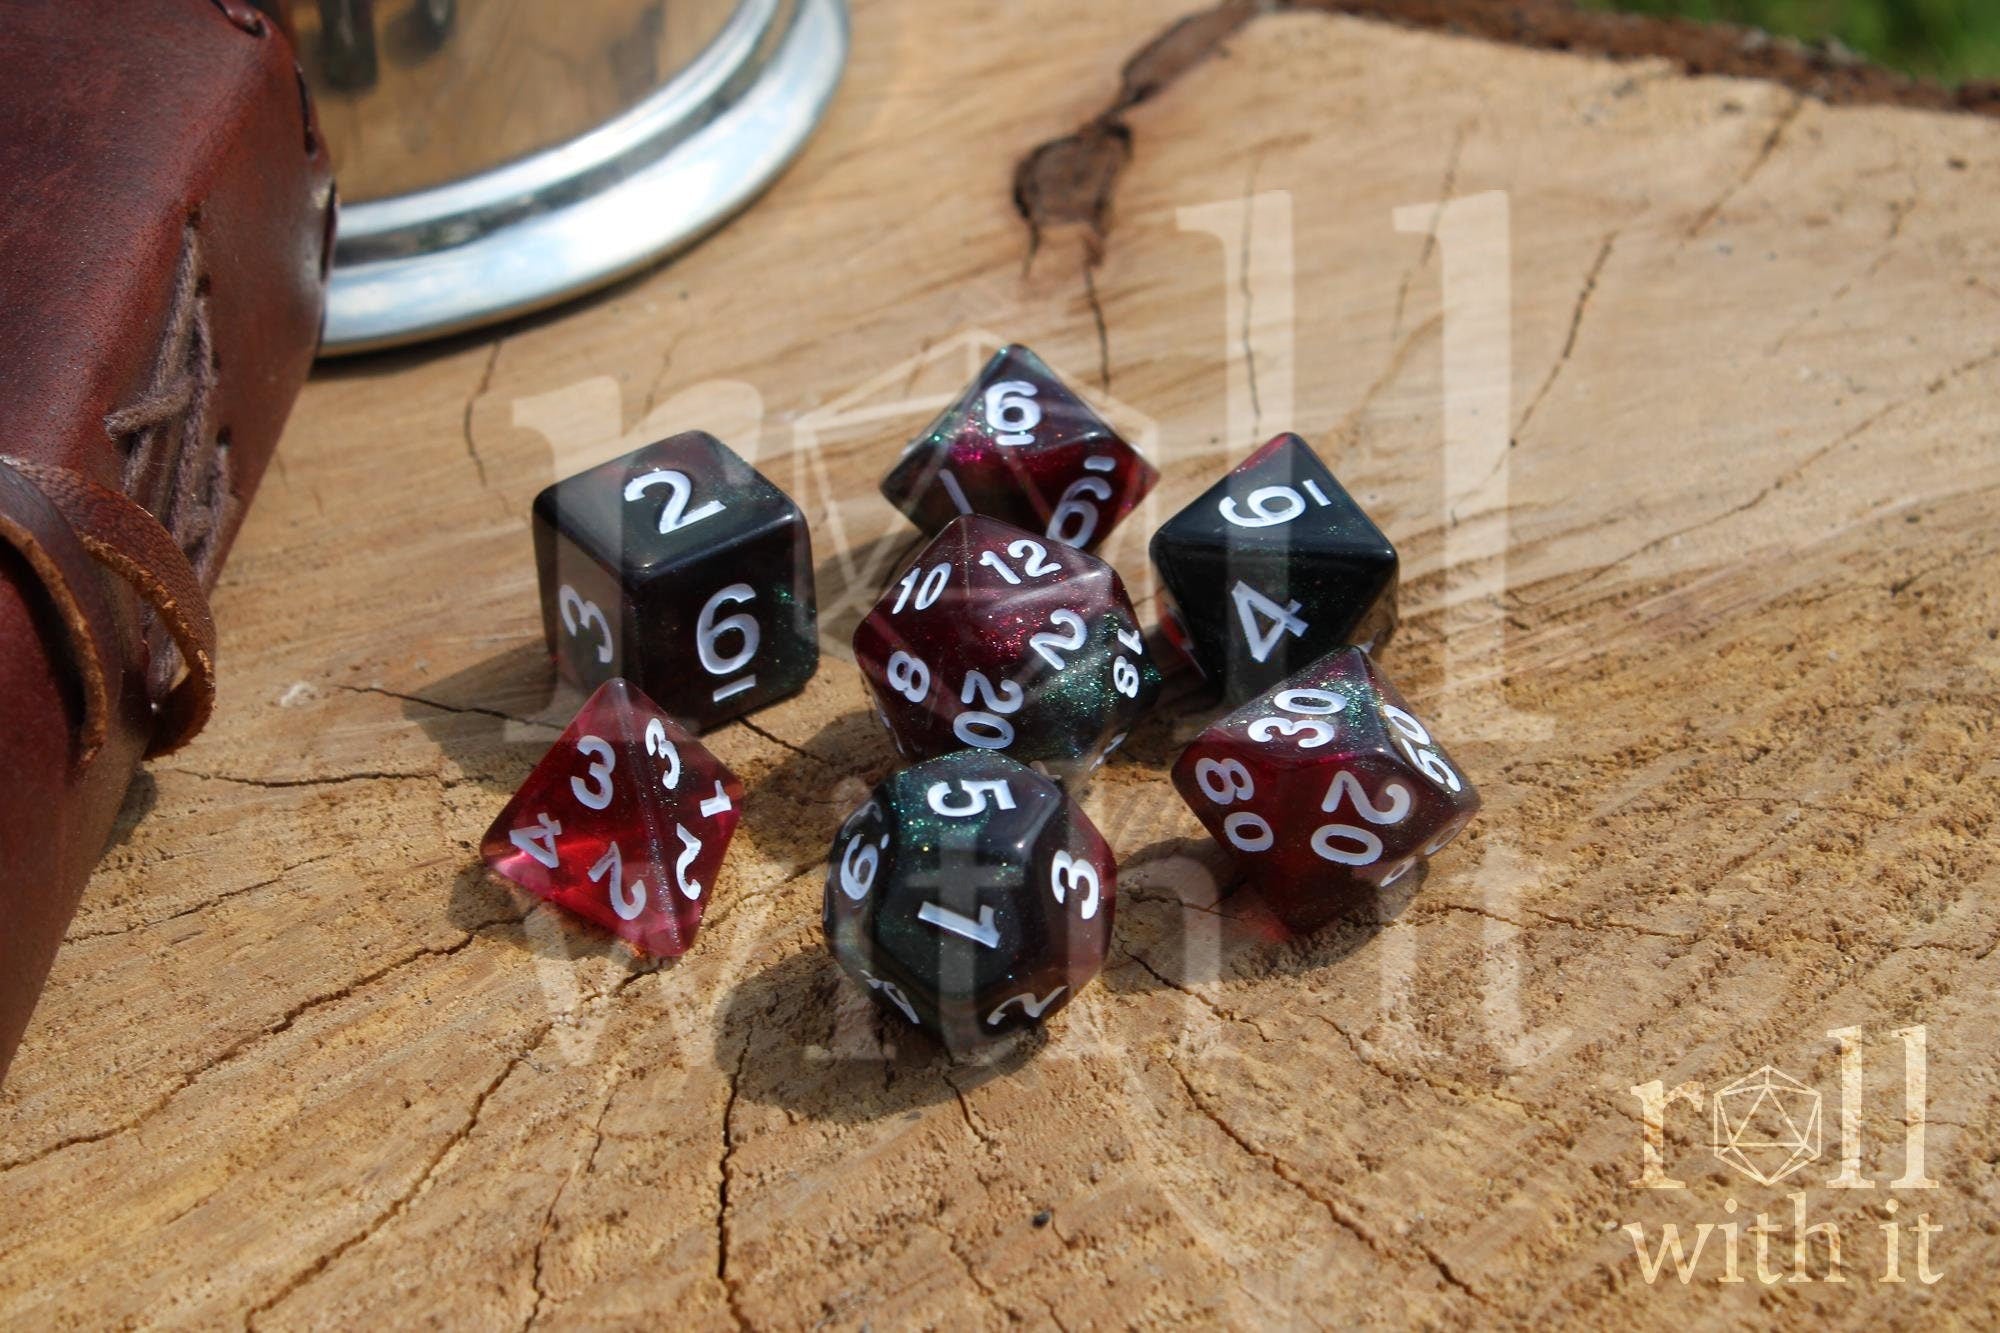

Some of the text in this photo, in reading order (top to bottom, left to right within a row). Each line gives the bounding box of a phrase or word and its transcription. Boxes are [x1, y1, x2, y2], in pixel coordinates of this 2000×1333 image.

[985, 381, 1042, 445] 6
[624, 470, 727, 534] 2
[892, 562, 951, 614] 10
[979, 539, 1062, 585] 12
[558, 584, 613, 663] 3
[696, 583, 761, 702] 6
[1029, 608, 1088, 671] 2
[1231, 580, 1309, 663] 4
[887, 650, 931, 703] 8
[1113, 628, 1143, 699] 18
[953, 670, 1025, 749] 20
[1248, 688, 1348, 748] 30
[570, 735, 616, 810] 3
[645, 718, 680, 789] 3
[1384, 704, 1461, 792] 50
[700, 780, 732, 818] 1
[927, 780, 1017, 817] 5
[1195, 757, 1275, 851] 80
[1311, 770, 1411, 866] 20
[509, 812, 562, 868] 4
[676, 823, 702, 900] 2
[588, 841, 647, 920] 2
[1051, 850, 1099, 920] 3
[917, 901, 1000, 949] 1
